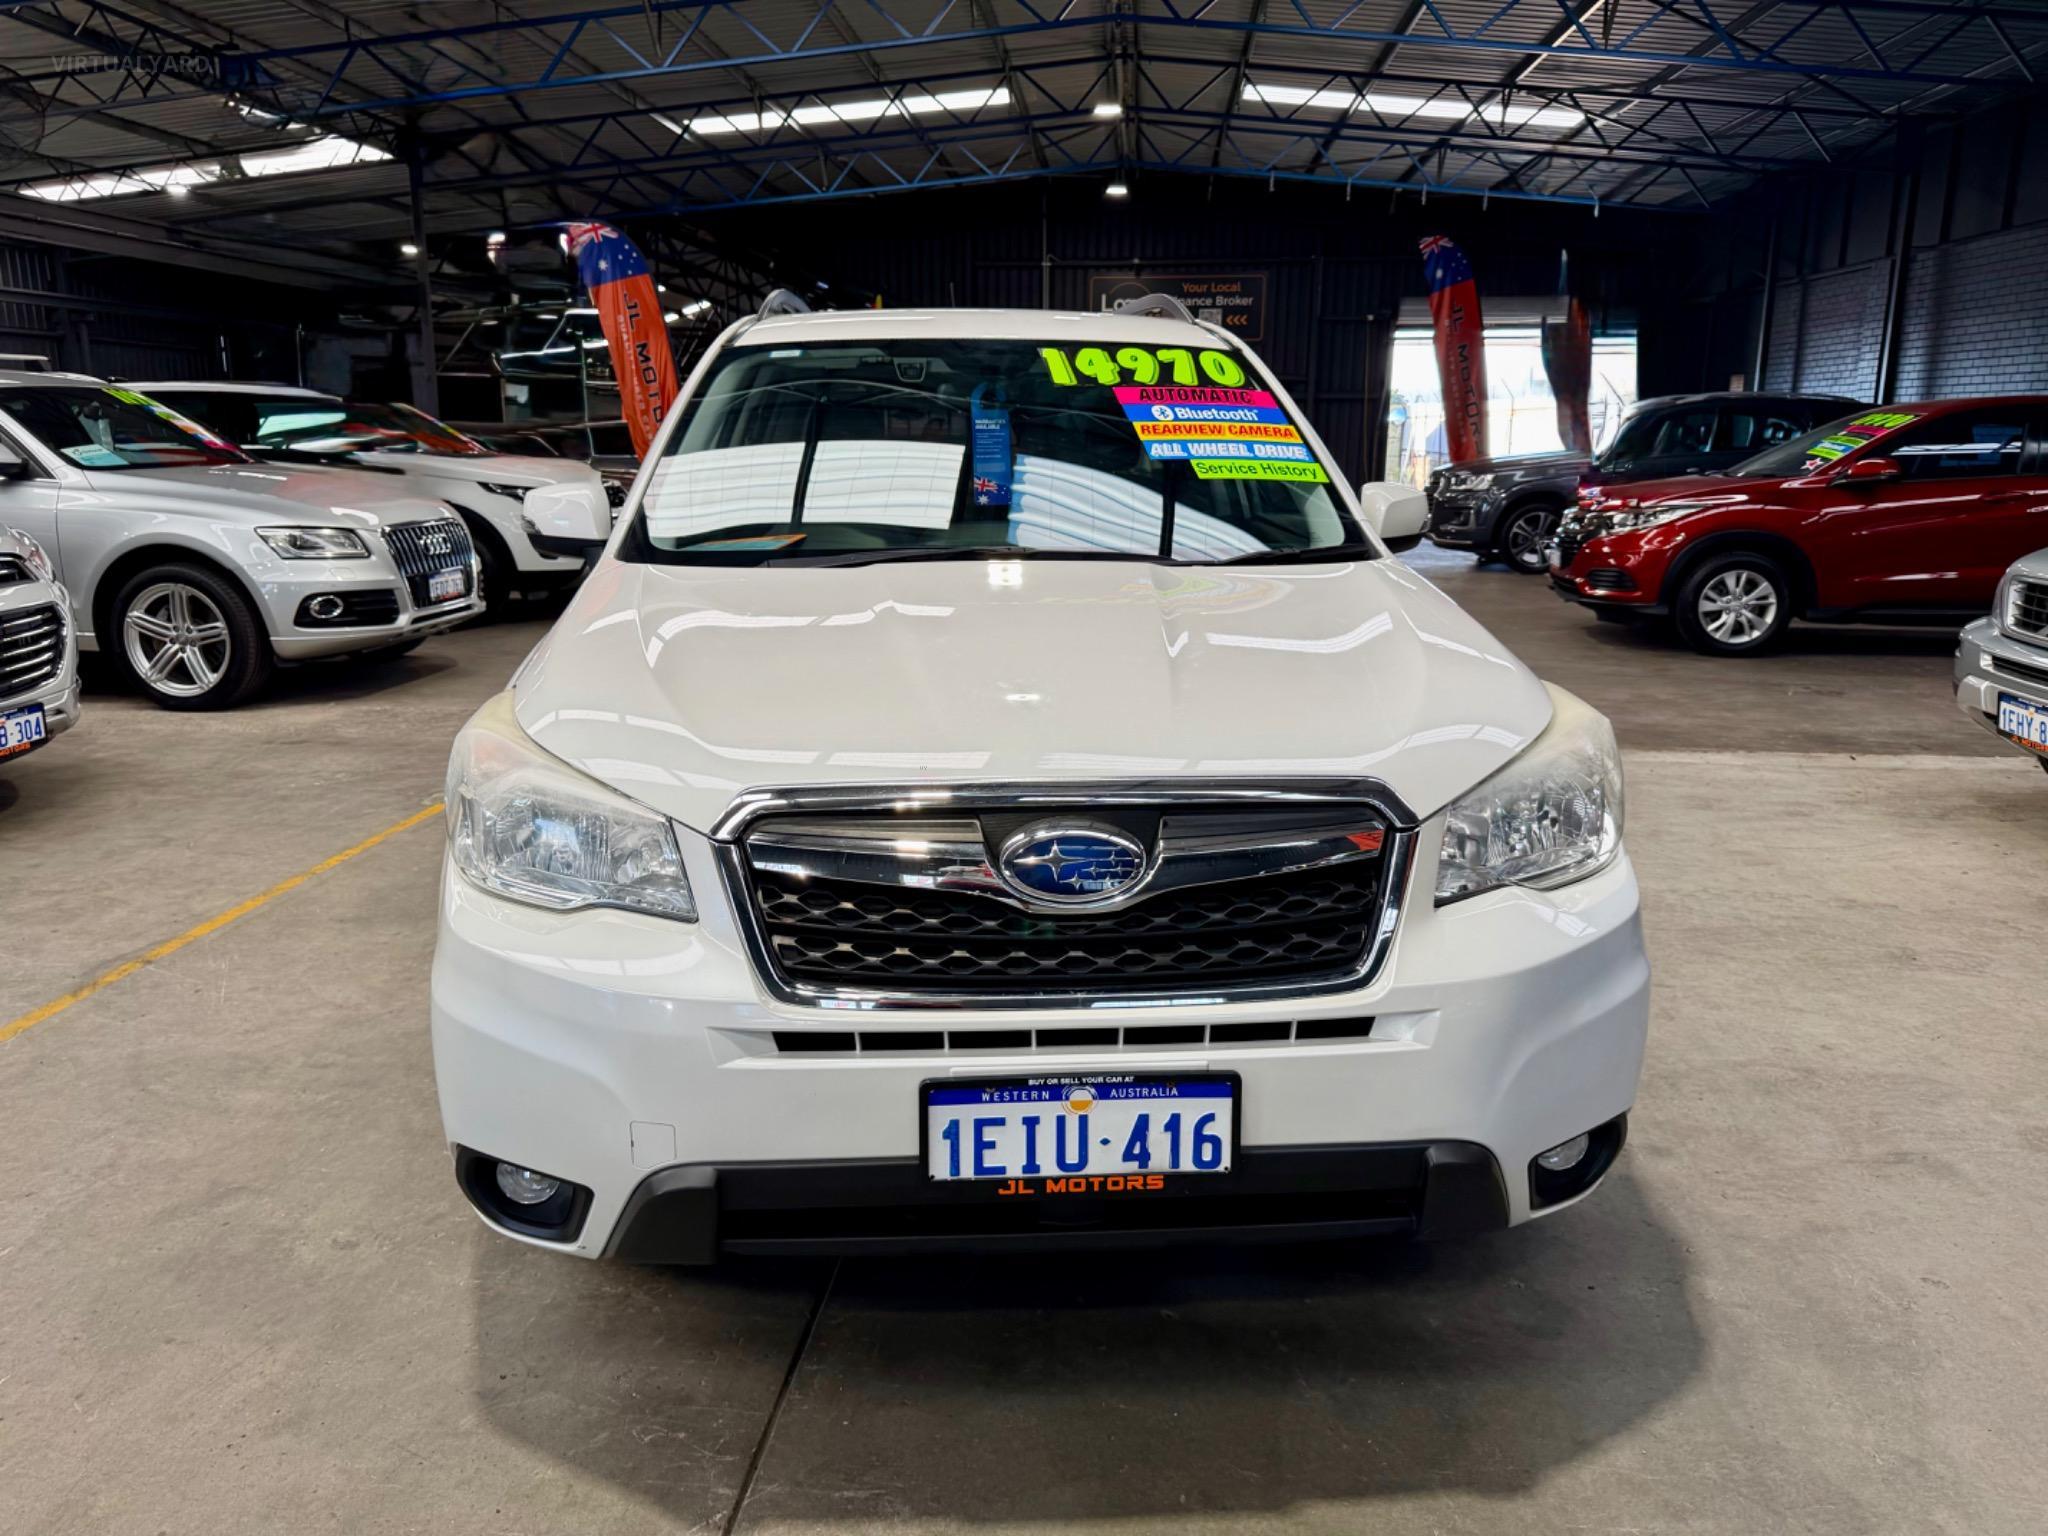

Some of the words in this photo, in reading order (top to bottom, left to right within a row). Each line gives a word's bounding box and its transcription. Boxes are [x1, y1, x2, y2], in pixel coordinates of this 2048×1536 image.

[1182, 282, 1208, 293] Your
[1211, 282, 1241, 293] Local
[1215, 294, 1254, 306] Broker
[623, 293, 641, 330] JL
[1040, 347, 1246, 387] 14970
[1139, 388, 1253, 405] AUTOMATIC
[1175, 406, 1259, 421] Bluetooth
[1140, 424, 1225, 438] REARVIEW
[1228, 424, 1295, 440] CAMERA
[1150, 442, 1188, 458] ALL
[1189, 442, 1251, 459] WHEEL
[1252, 444, 1309, 459] DRIVE
[1197, 461, 1257, 476] Service
[1262, 463, 1318, 479] History
[981, 1090, 1050, 1102] WESTERN
[1110, 1087, 1179, 1098] AUSTRALIA
[998, 1180, 1034, 1195] JL
[1047, 1175, 1164, 1193] MOTORS
